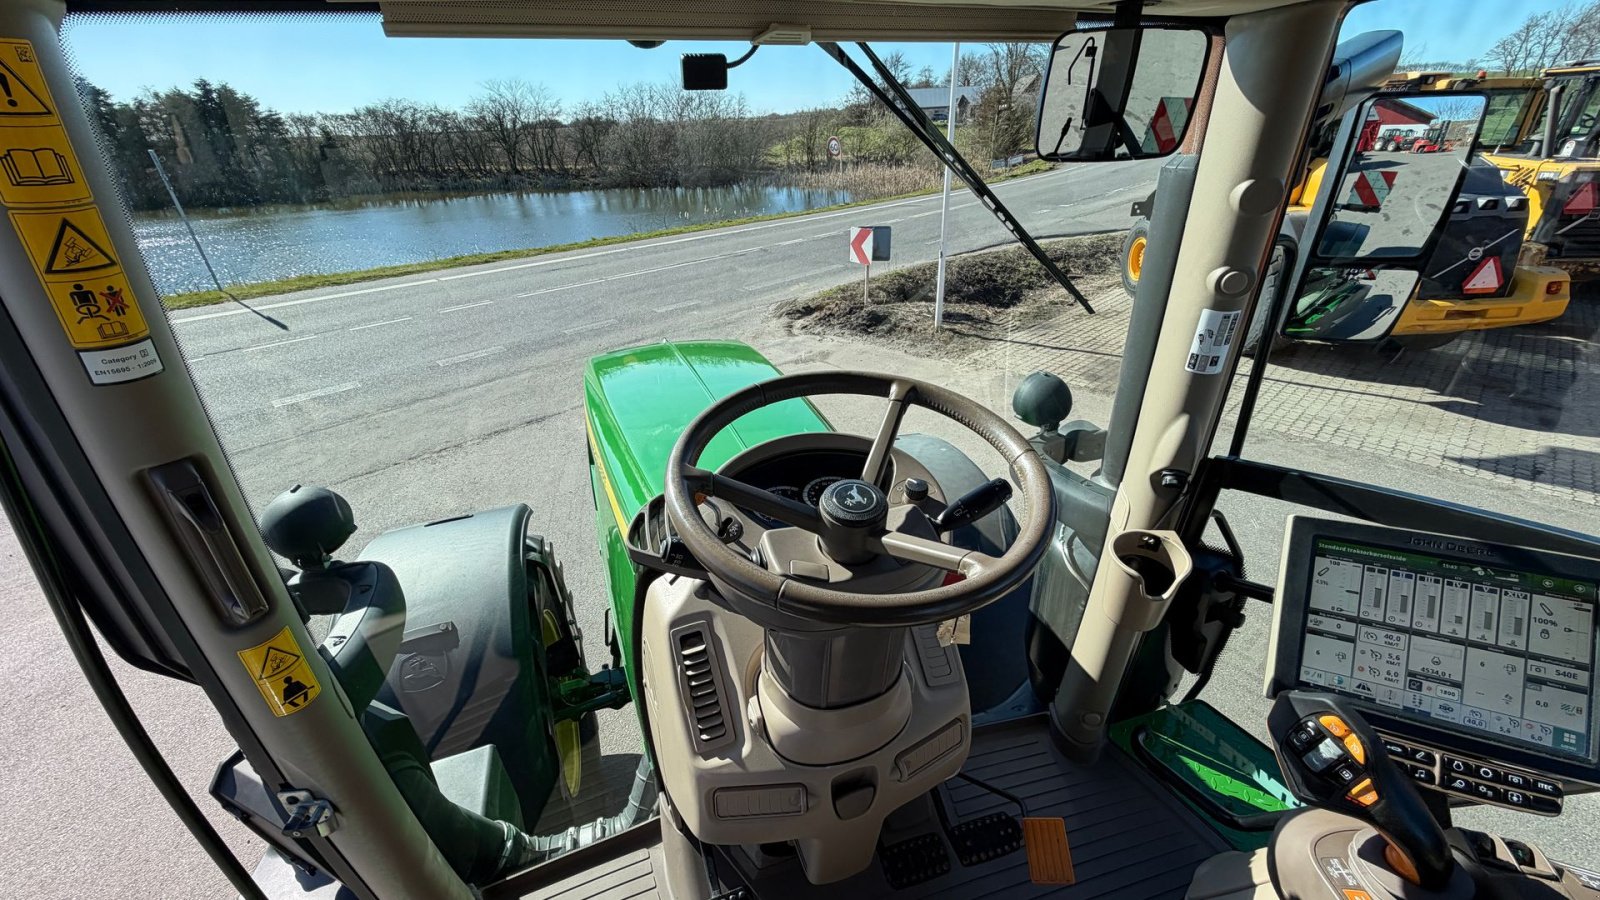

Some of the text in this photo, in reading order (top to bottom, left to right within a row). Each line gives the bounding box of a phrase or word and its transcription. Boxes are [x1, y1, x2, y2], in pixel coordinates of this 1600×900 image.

[101, 353, 137, 365] Category
[1318, 542, 1346, 551] Standard
[1408, 536, 1497, 558] JOHN DEERE
[1532, 616, 1558, 627] 100%
[1383, 632, 1400, 642] 40,0
[1387, 652, 1400, 662] 5,6
[1385, 669, 1398, 678] 6,0
[1554, 668, 1578, 680] 540E
[1537, 782, 1553, 791] ITEC
